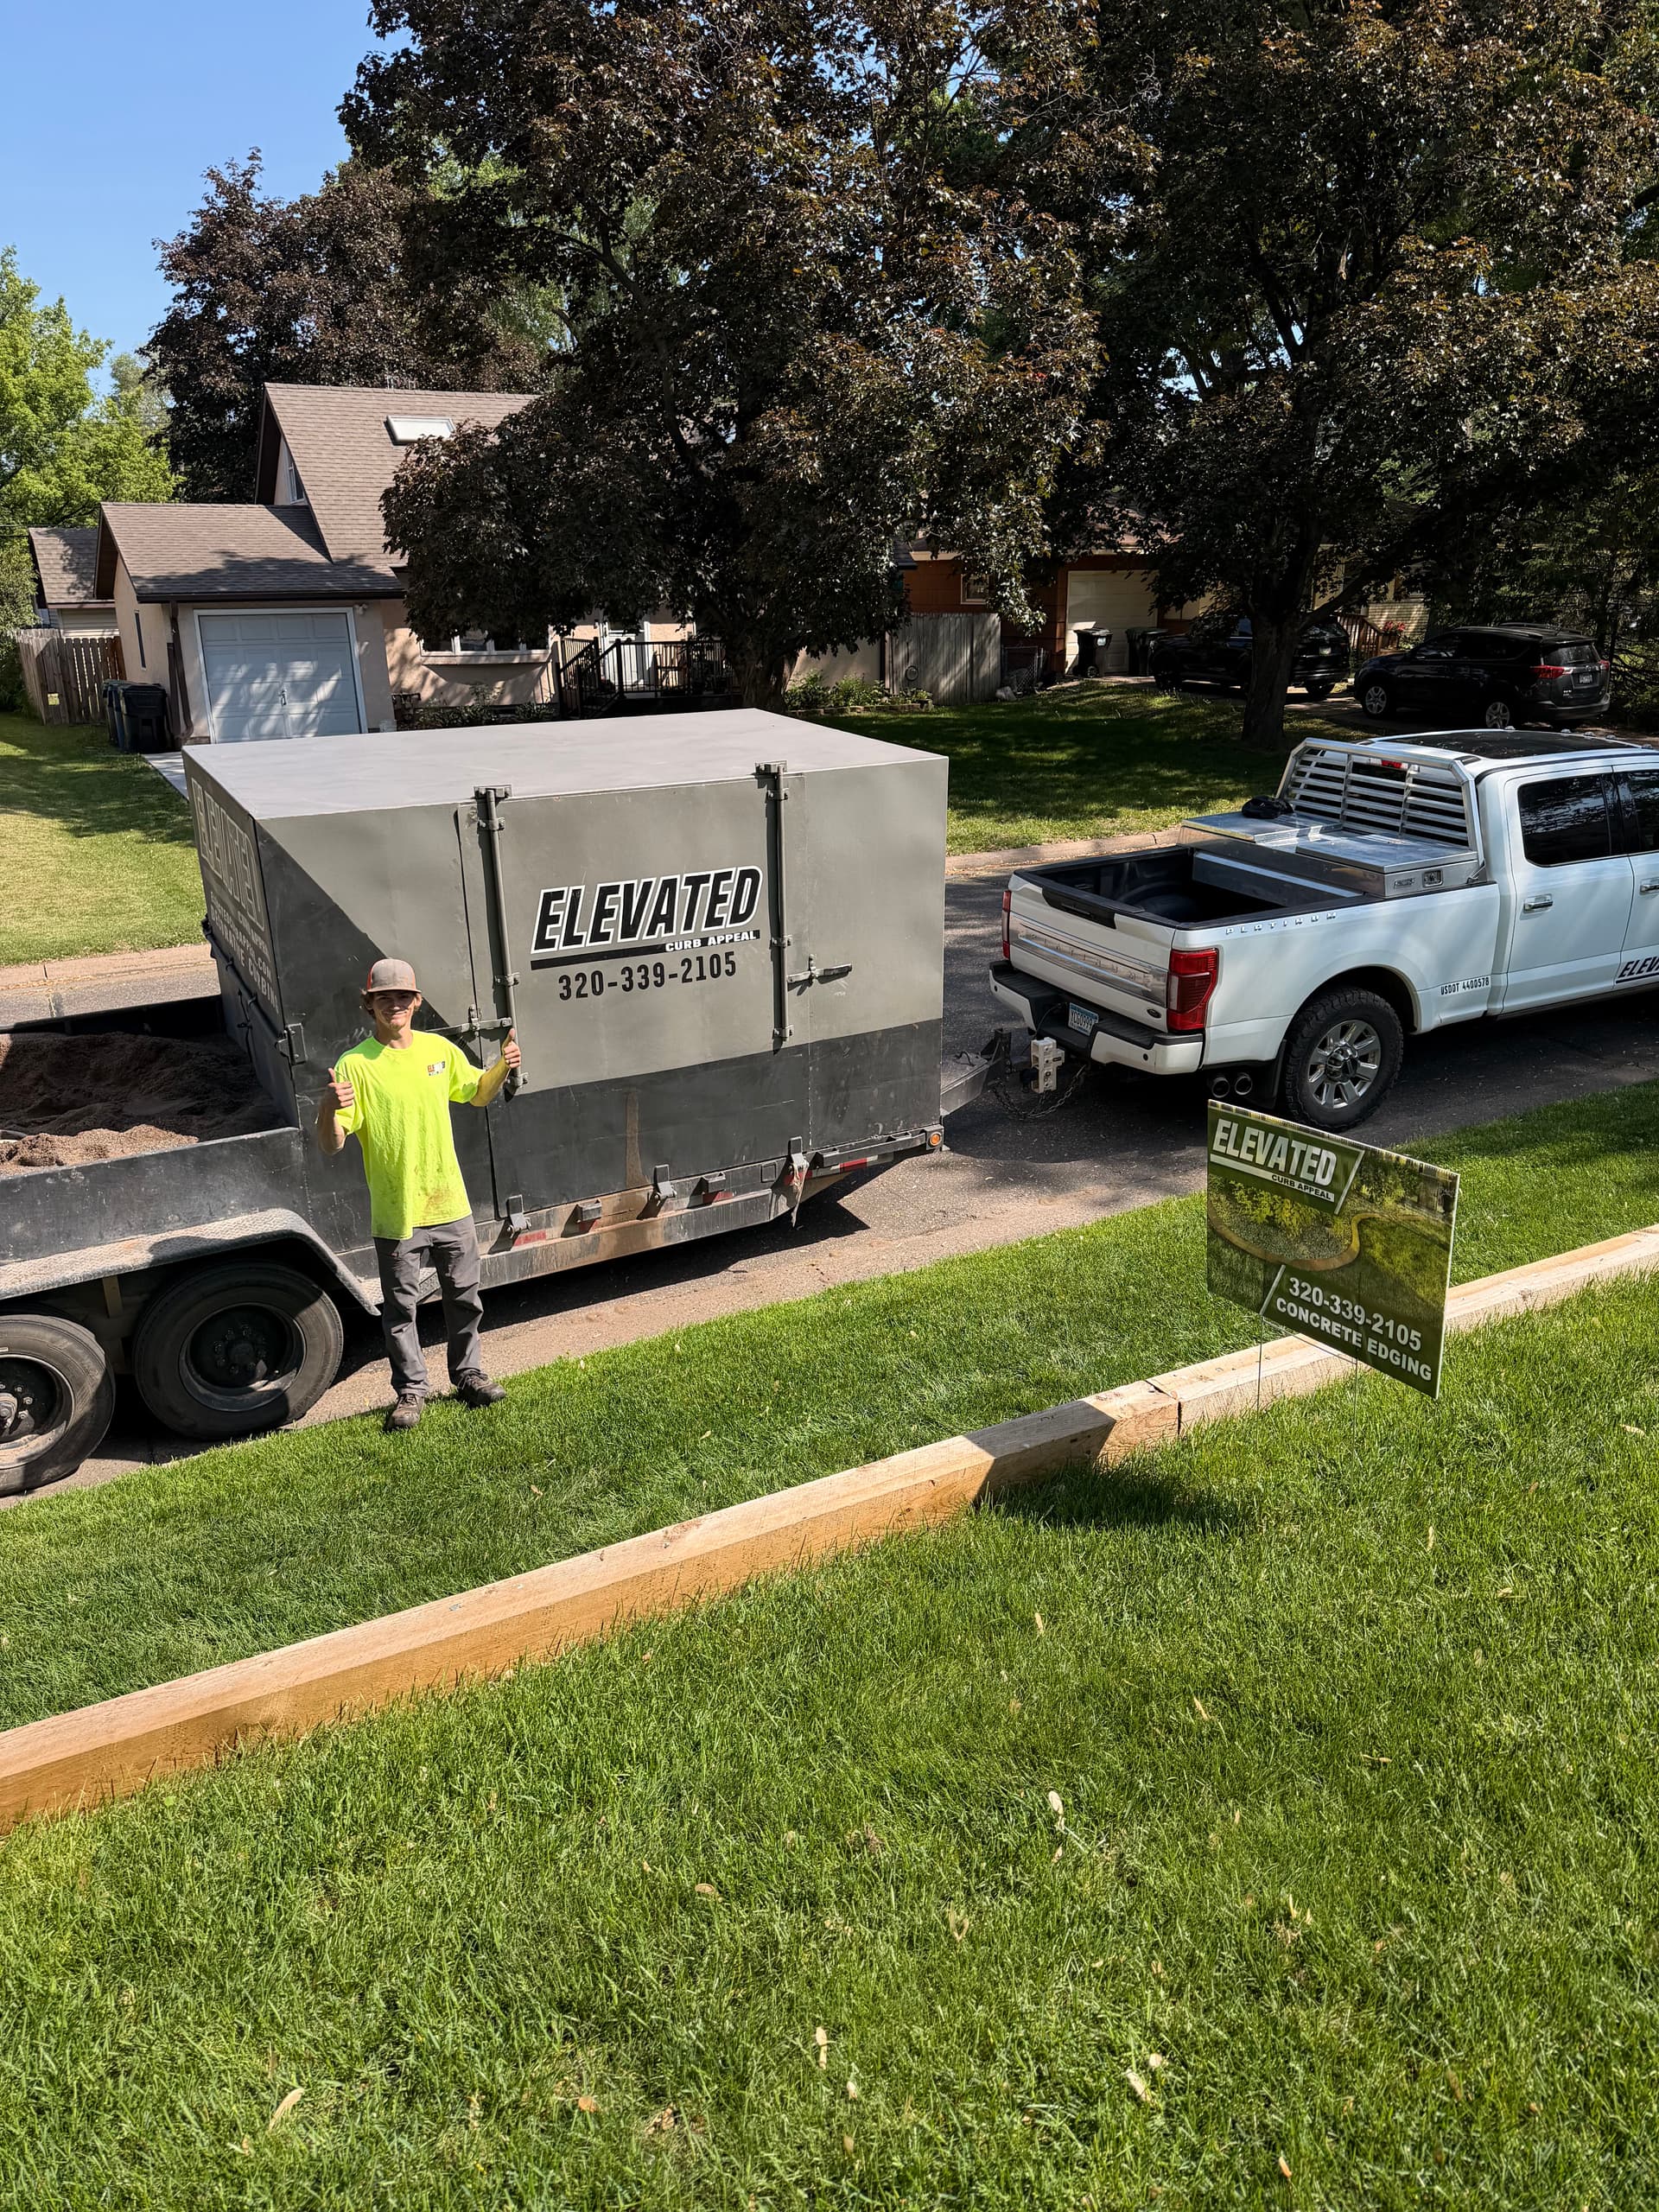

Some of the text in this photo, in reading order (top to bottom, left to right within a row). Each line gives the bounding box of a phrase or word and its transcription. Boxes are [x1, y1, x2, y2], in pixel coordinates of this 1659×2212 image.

[531, 865, 763, 954] ELEVATED
[1225, 912, 1337, 935] PLATINUM
[665, 931, 757, 952] CURB APPEAL
[557, 951, 736, 1001] 320-339-2105
[1440, 976, 1490, 995] USDOT 4400578
[1211, 1118, 1338, 1187] ELEVATED
[1271, 1173, 1332, 1201] CURB APPEAL
[1288, 1277, 1422, 1352] 320-339-2105
[1276, 1298, 1433, 1382] CONCRETE EDGING
